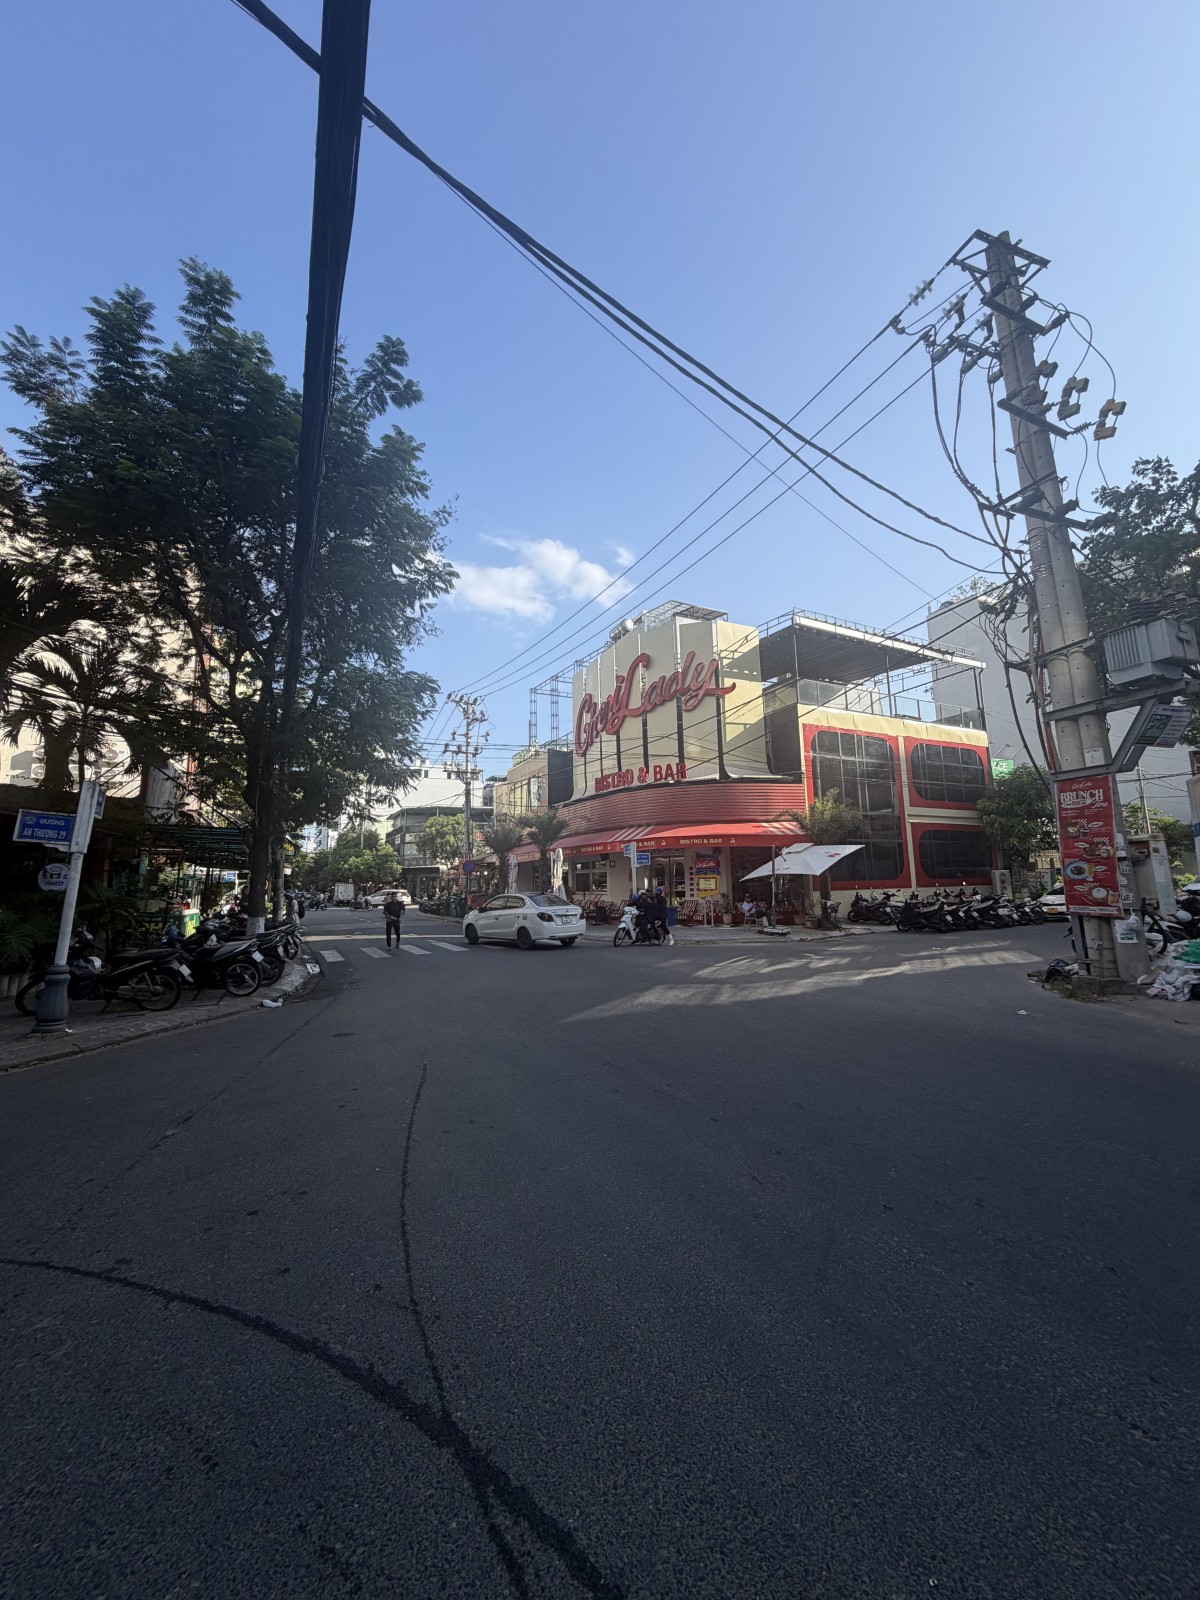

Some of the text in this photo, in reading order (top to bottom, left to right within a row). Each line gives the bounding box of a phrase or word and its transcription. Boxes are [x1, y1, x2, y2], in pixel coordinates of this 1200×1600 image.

[605, 651, 737, 735] Lady
[595, 762, 688, 793] BISTRO & BAR
[1060, 789, 1104, 803] BRUNCH
[23, 828, 32, 836] AN
[58, 830, 67, 839] 29
